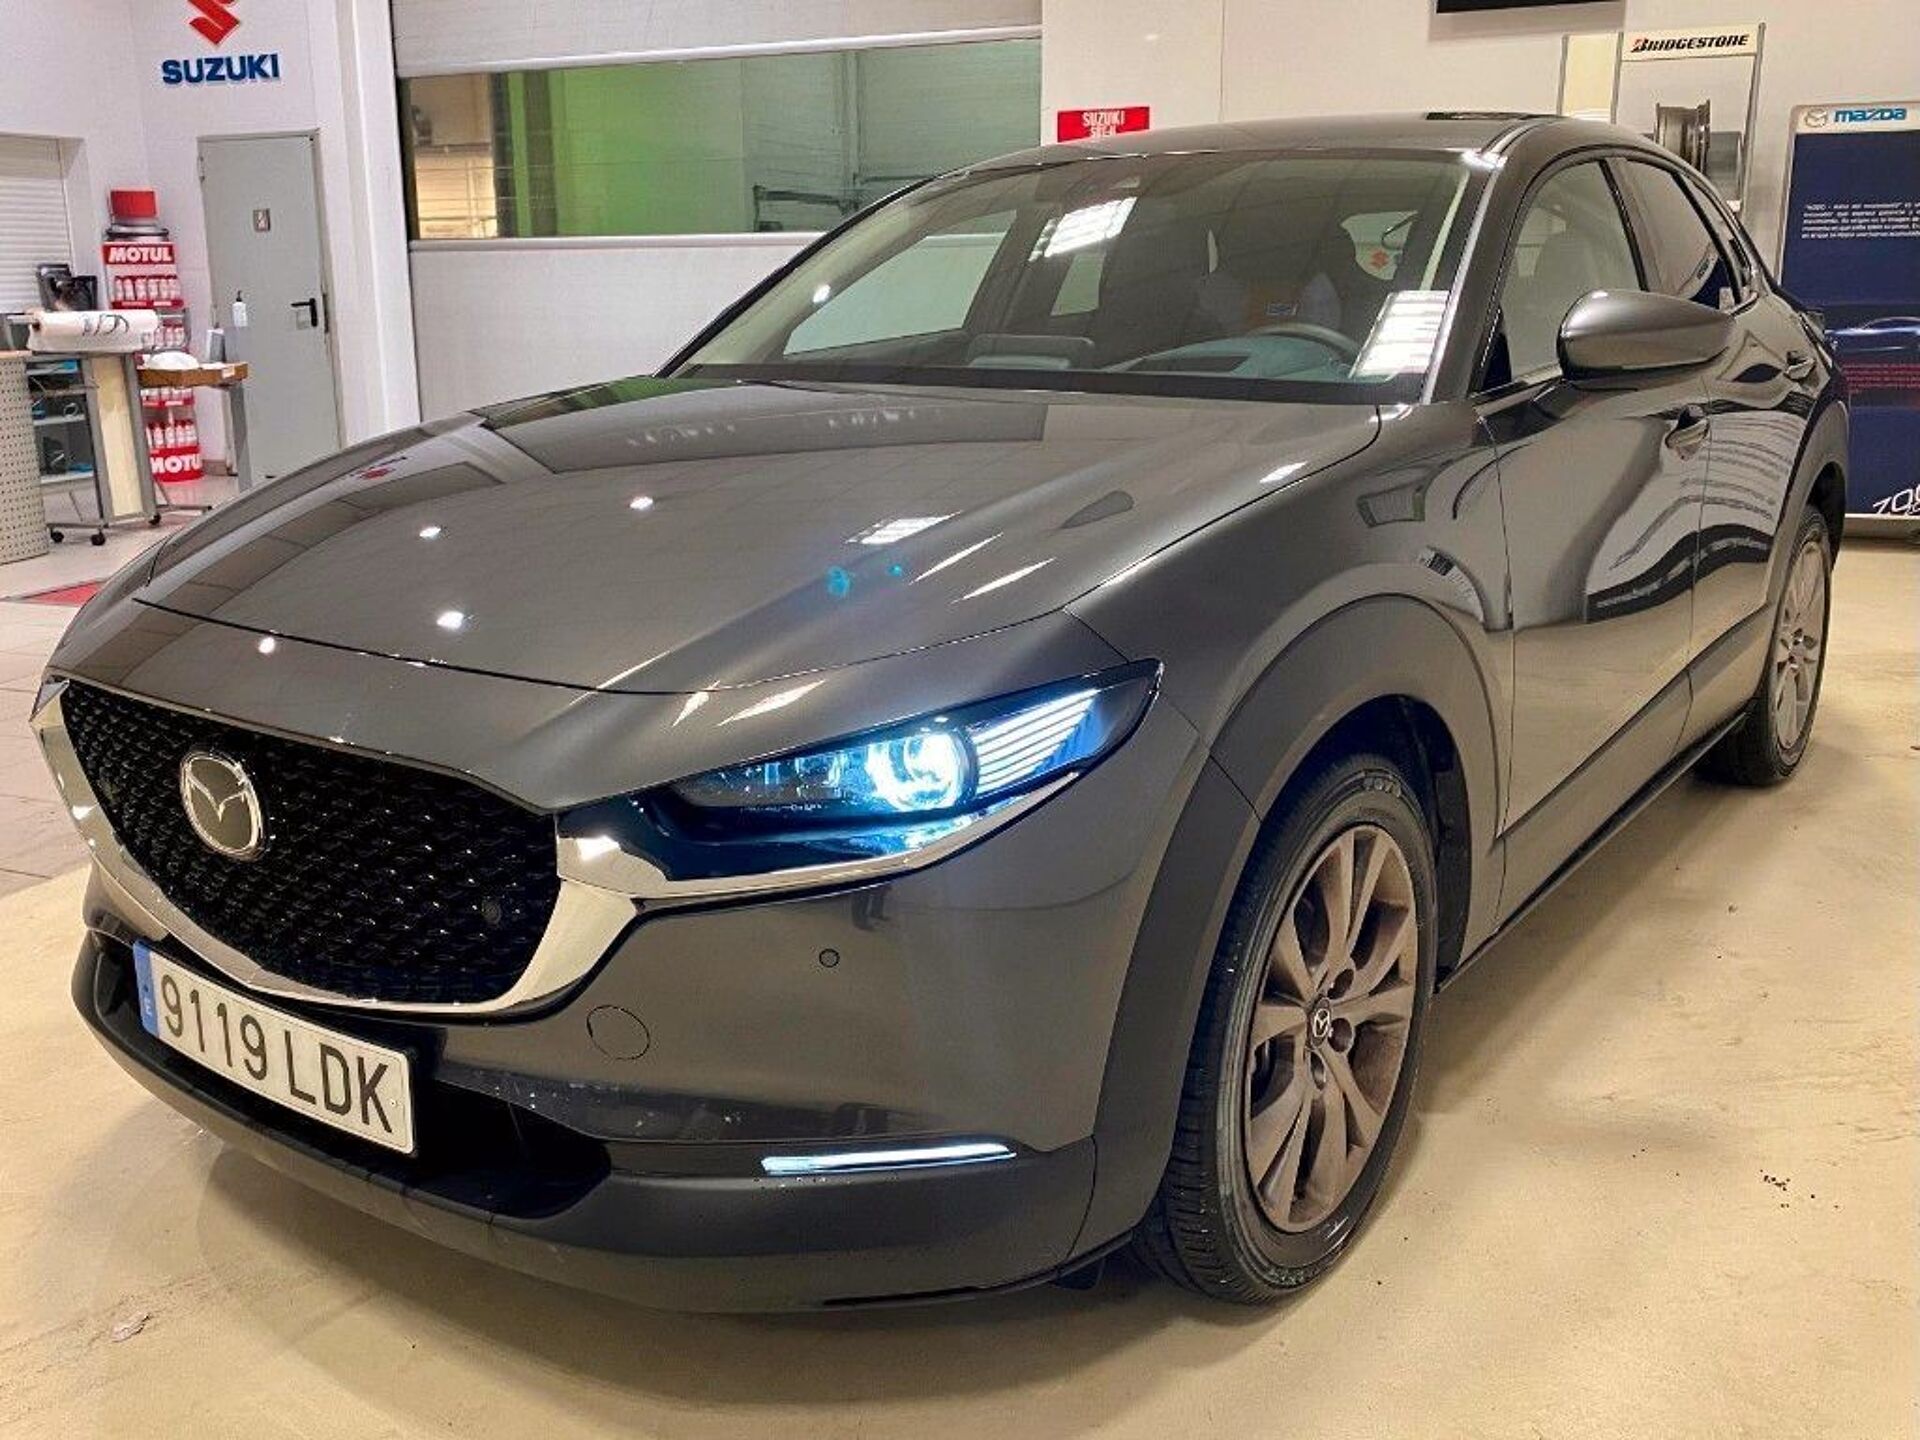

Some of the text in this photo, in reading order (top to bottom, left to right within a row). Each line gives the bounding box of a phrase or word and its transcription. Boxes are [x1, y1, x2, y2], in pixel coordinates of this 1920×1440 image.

[1631, 34, 1750, 53] BRIDGESTONE
[162, 53, 281, 84] SUZUKI
[1082, 110, 1126, 127] SUZUKI
[1834, 107, 1907, 123] mazda
[108, 247, 172, 262] MOTUL
[160, 973, 393, 1133] 9119 LDK
